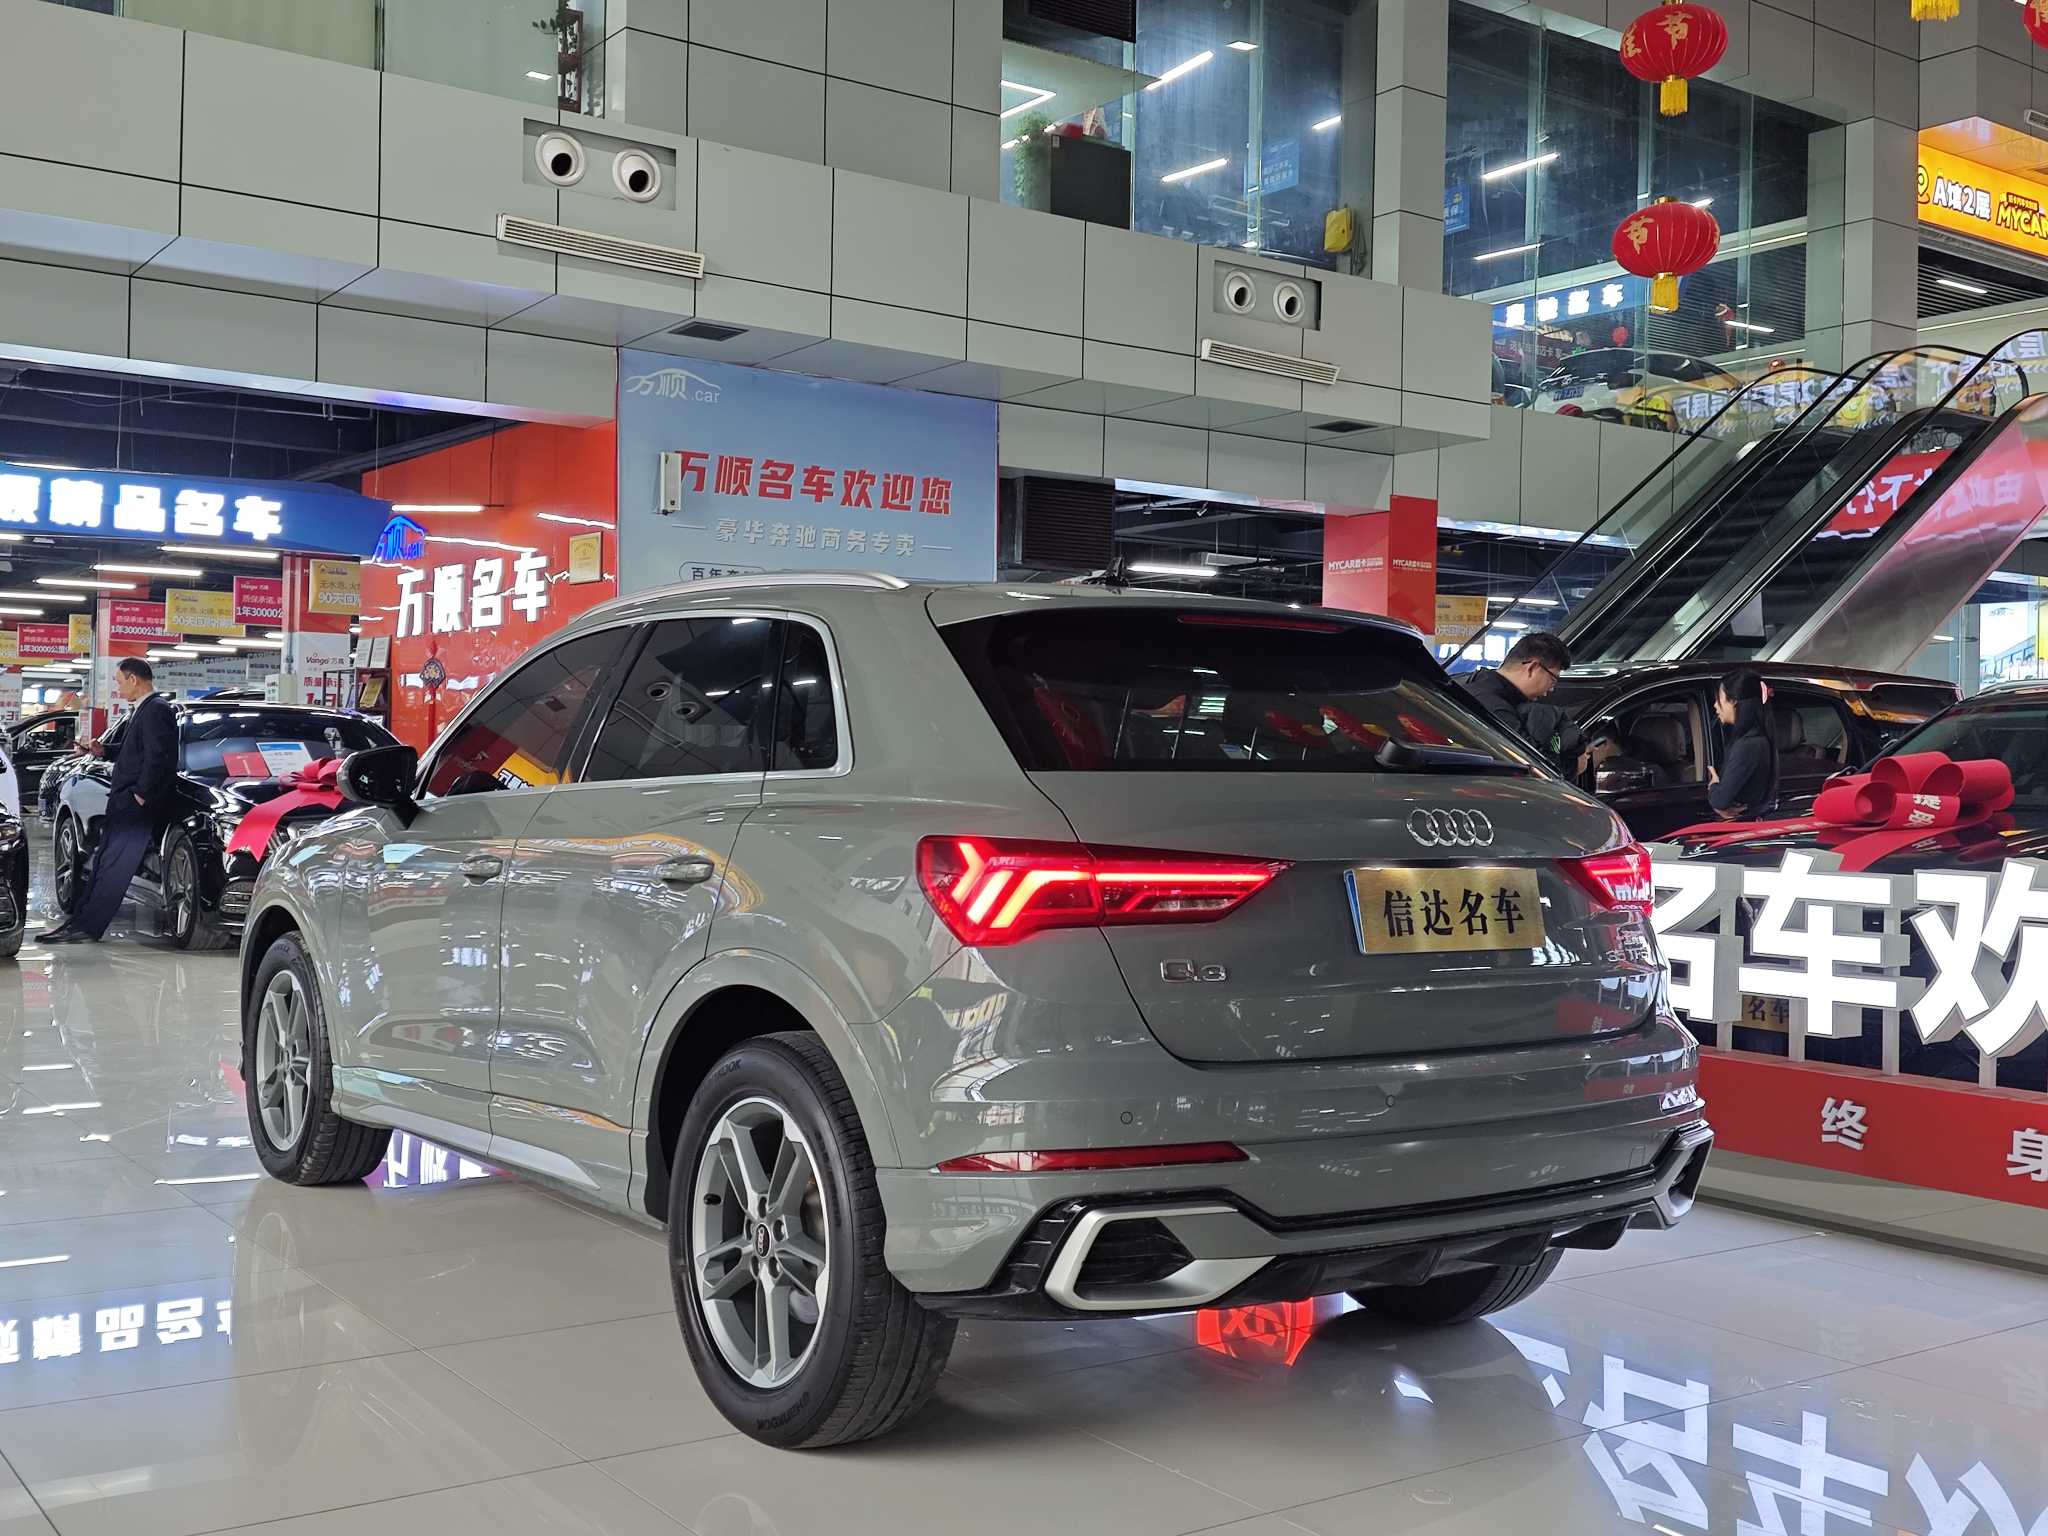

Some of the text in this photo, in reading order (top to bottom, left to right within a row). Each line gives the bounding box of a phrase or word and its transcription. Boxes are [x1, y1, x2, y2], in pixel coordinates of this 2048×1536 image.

[675, 450, 952, 516] 万顺名车欢迎您
[714, 519, 916, 557] 豪华奔驰商务专卖
[396, 551, 549, 638] 万顺名车
[1384, 888, 1525, 939] 信达名车
[1820, 1096, 1868, 1151] 终
